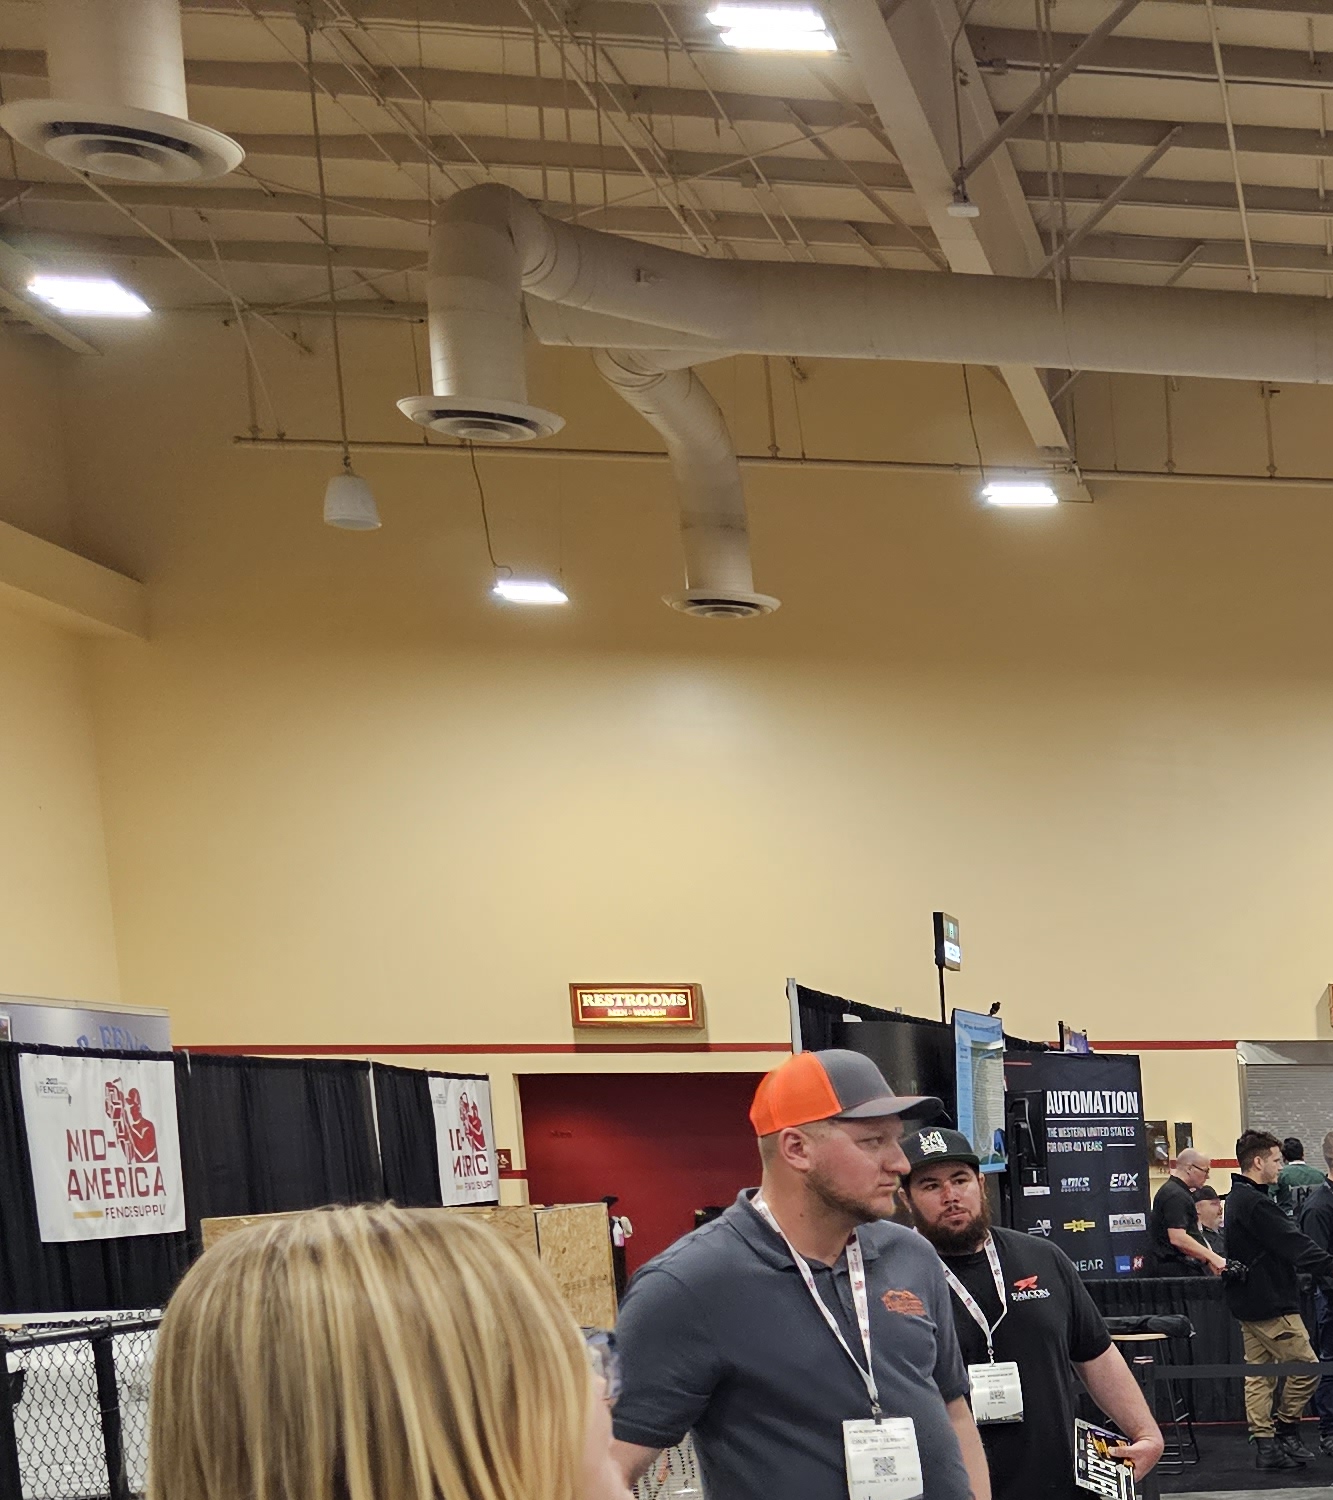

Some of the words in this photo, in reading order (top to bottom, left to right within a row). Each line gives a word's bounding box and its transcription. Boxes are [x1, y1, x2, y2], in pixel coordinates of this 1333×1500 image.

[582, 993, 687, 1007] RESTROOMS
[607, 1008, 628, 1017] MEN
[634, 1008, 667, 1017] WOMEN
[1046, 1090, 1139, 1115] AUTOMATION
[1047, 1127, 1058, 1138] THE
[1059, 1127, 1086, 1138] WESTERN
[1087, 1127, 1109, 1138] UNITED
[1110, 1126, 1135, 1137] STATES
[66, 1129, 117, 1162] MID-
[1046, 1142, 1057, 1153] FOR
[1058, 1142, 1072, 1152] OVER
[1073, 1142, 1081, 1152] 40
[1083, 1141, 1103, 1152] YEARS
[67, 1166, 167, 1201] AMERICA
[1110, 1172, 1139, 1188] EMX
[1072, 1259, 1104, 1271] NEAR
[1011, 1288, 1051, 1302] FALCON
